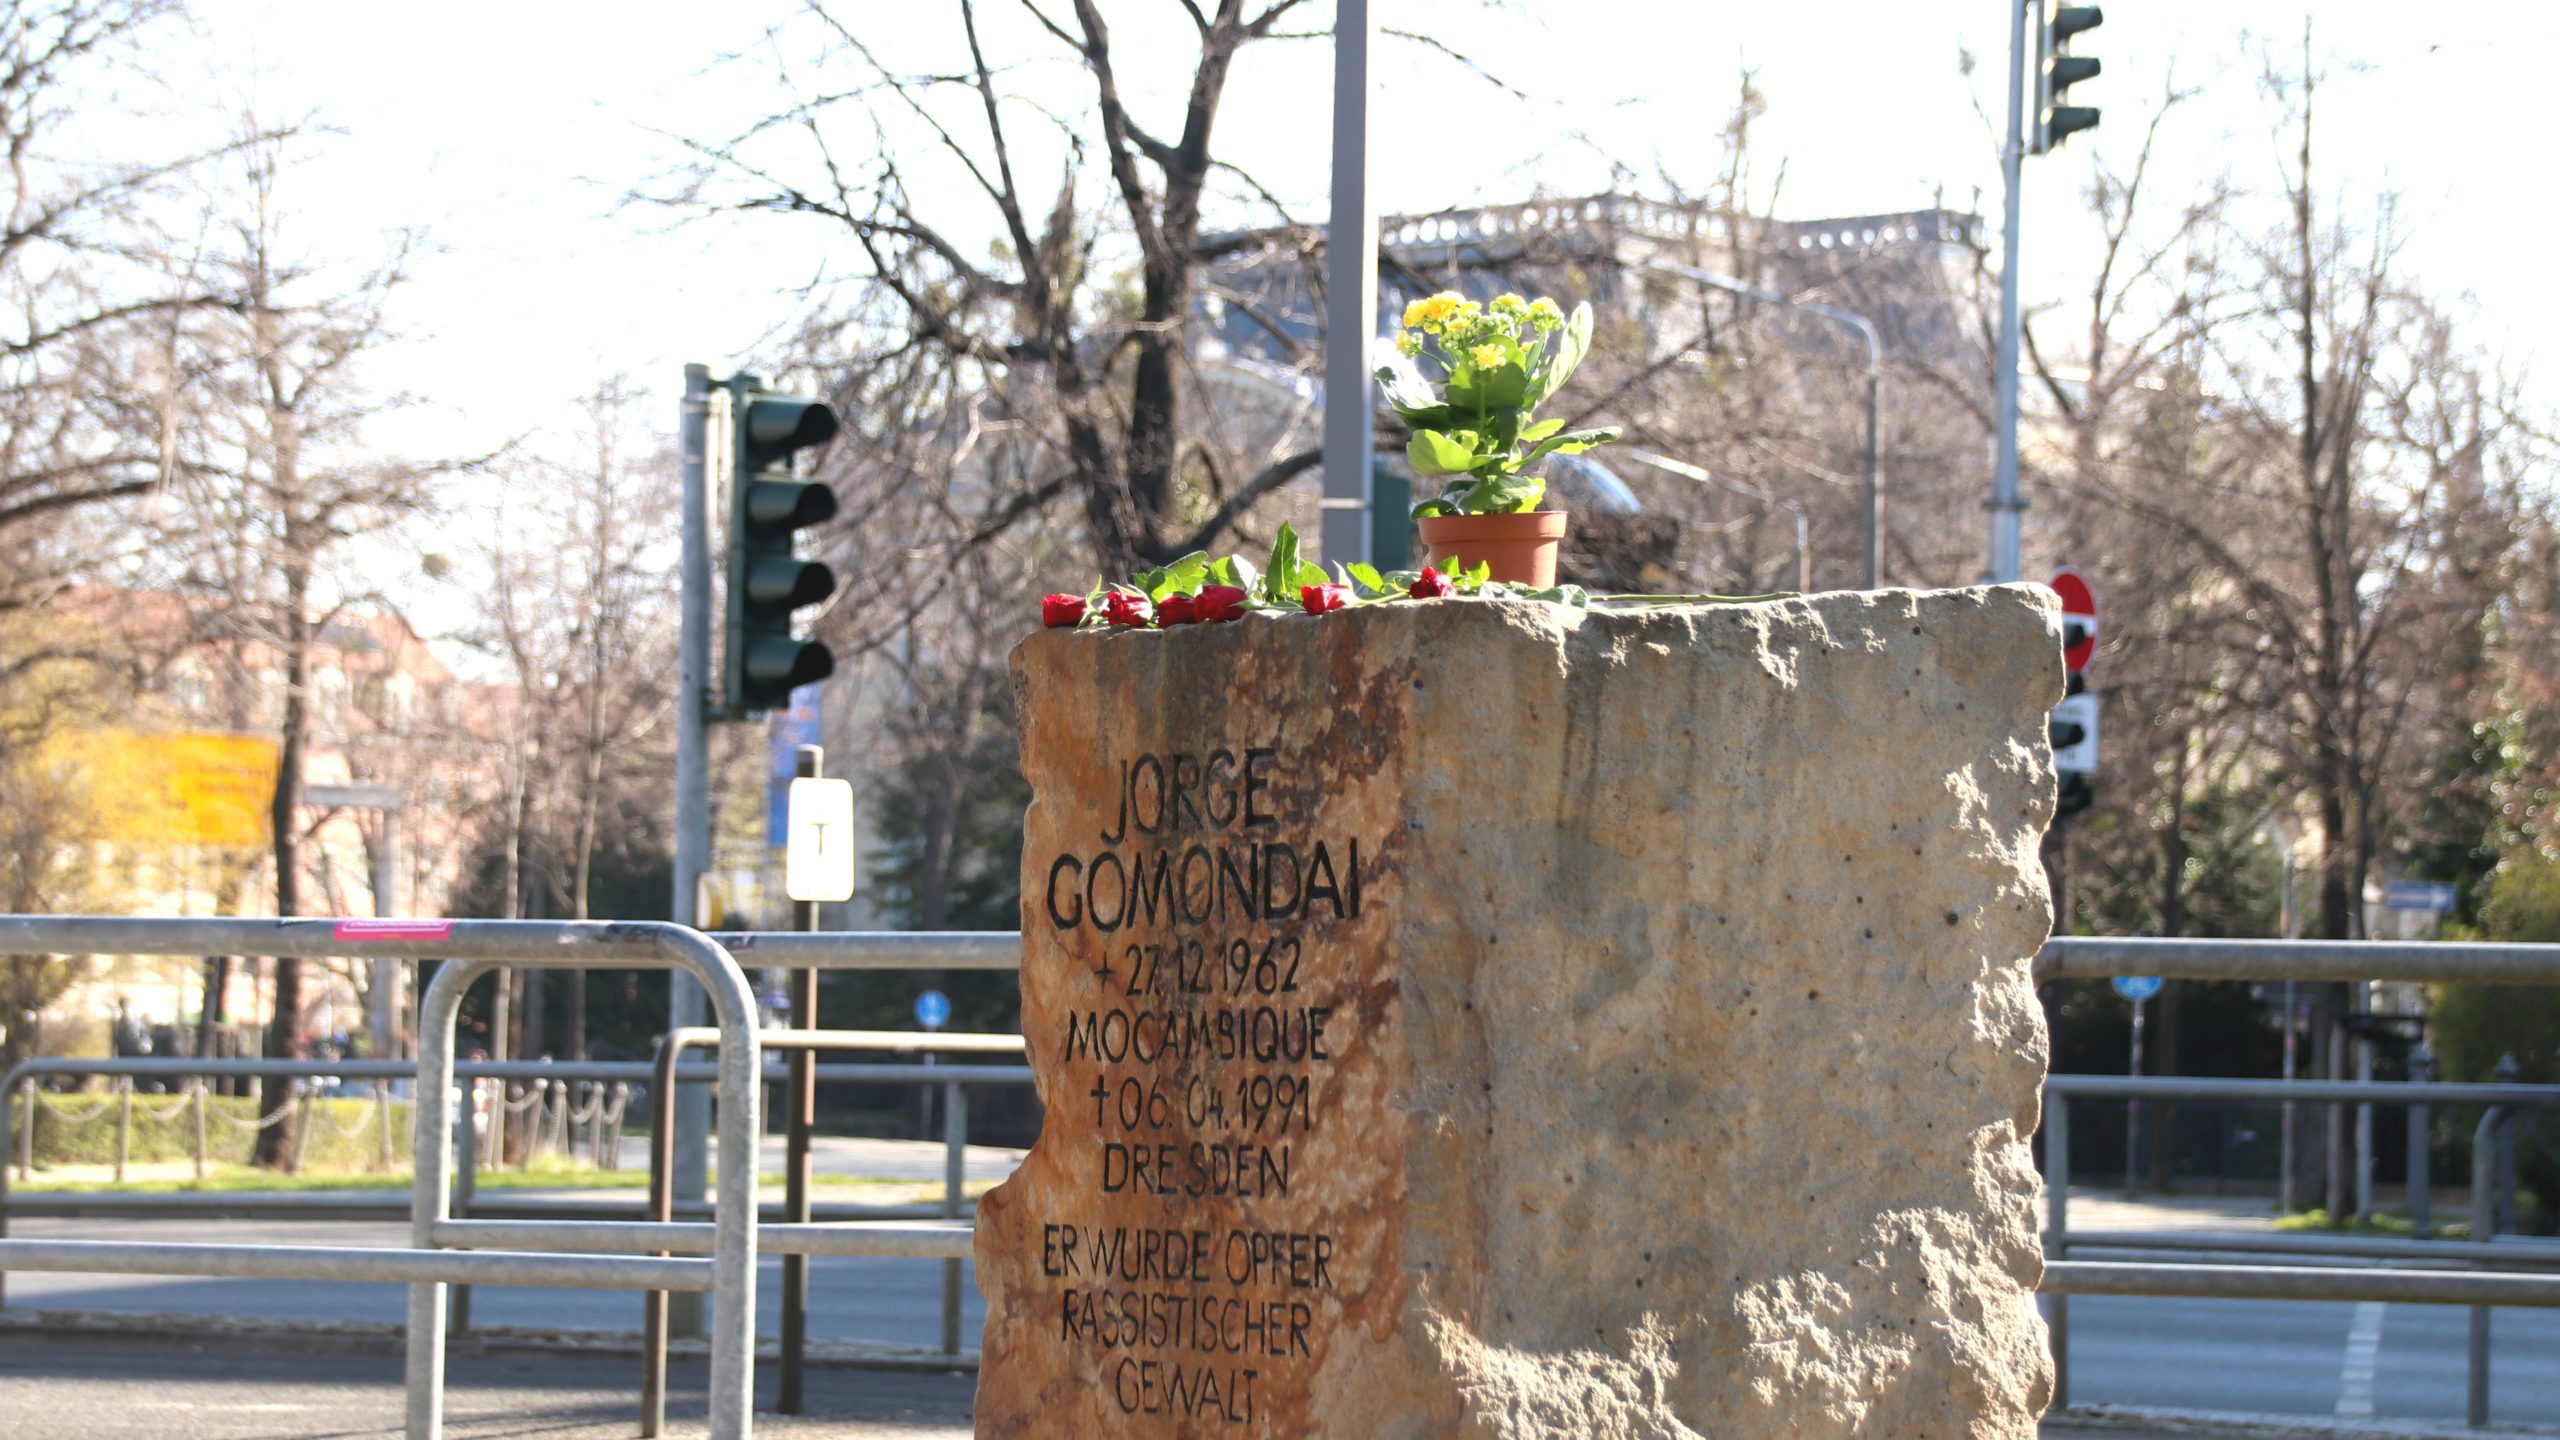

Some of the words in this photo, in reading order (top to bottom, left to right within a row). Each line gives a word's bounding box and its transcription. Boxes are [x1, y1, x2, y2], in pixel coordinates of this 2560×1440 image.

[1101, 747, 1276, 845] JORGE
[1047, 837, 1360, 932] GOMONDAI
[1103, 1143, 1289, 1198] DRESDEN
[1044, 1224, 1081, 1277] ER
[1084, 1227, 1211, 1284] WURDE
[1225, 1230, 1333, 1289] OPFER
[1062, 1290, 1312, 1358] RASSISTISCHER
